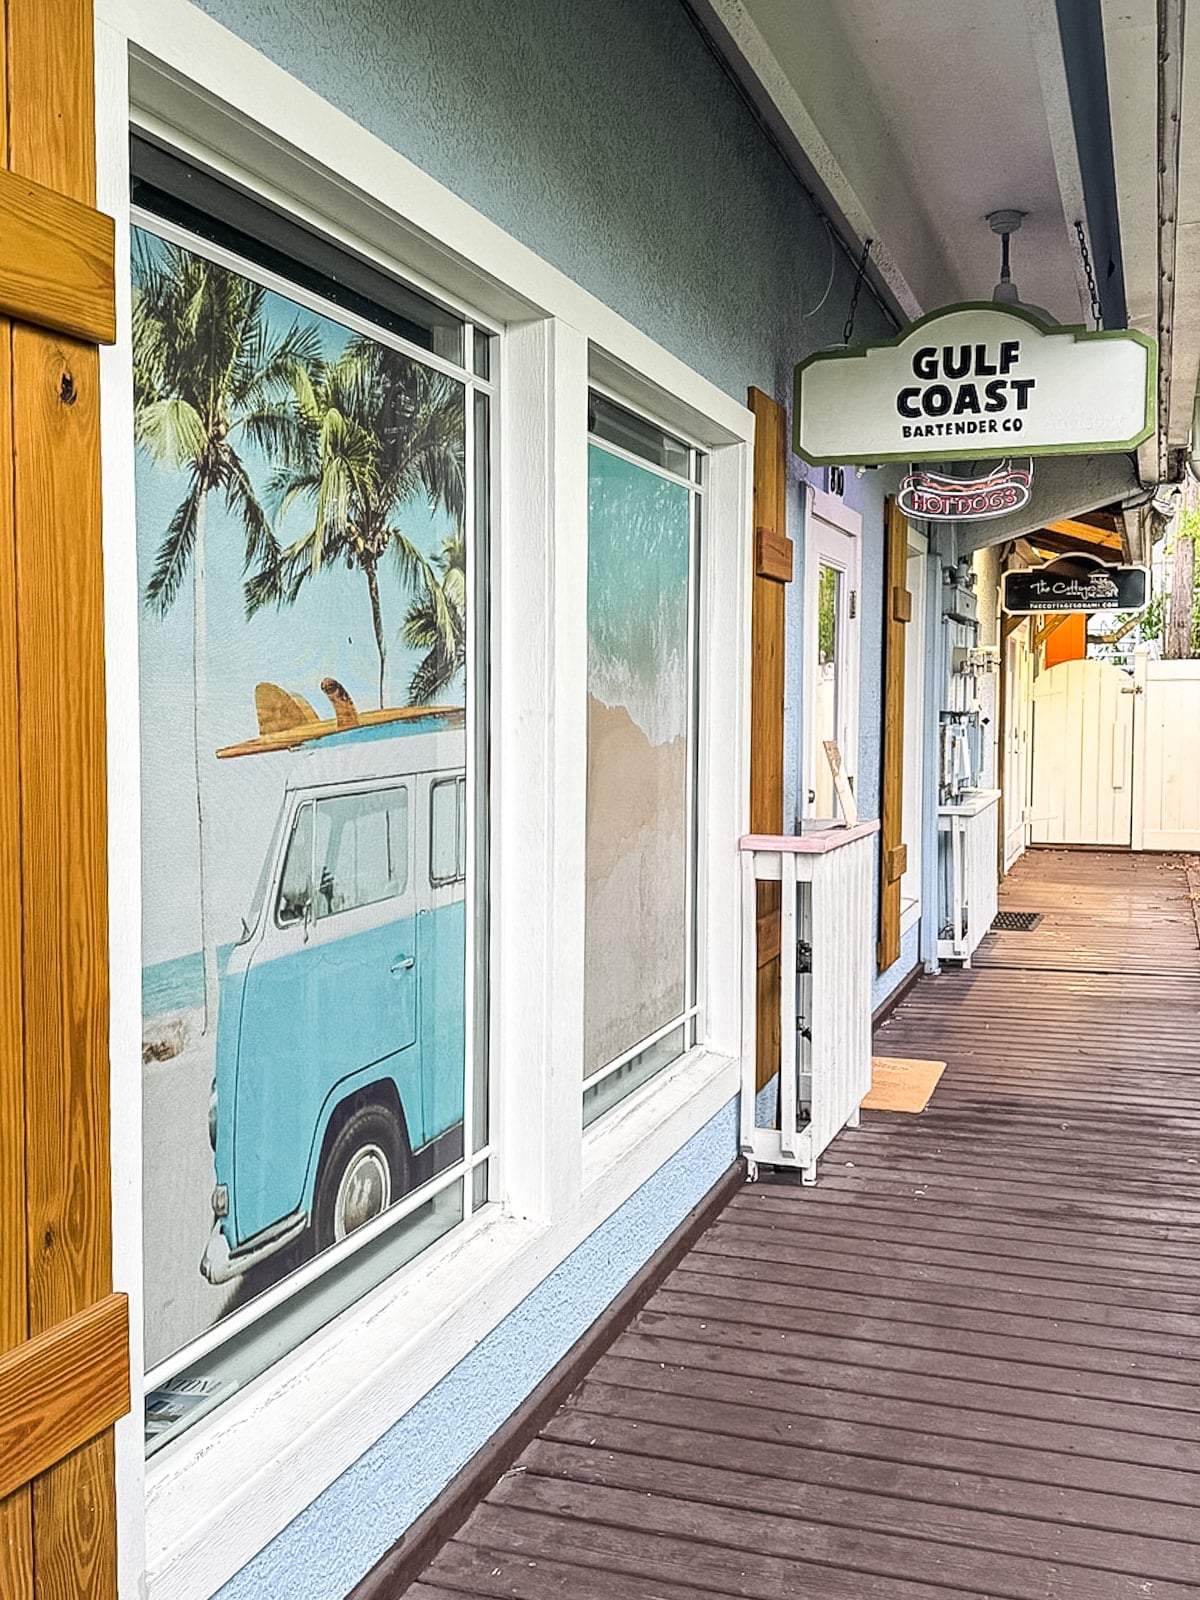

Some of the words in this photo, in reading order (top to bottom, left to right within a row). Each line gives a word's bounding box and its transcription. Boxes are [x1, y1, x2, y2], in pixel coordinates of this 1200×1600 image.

[912, 340, 1020, 381] GULF
[896, 379, 1036, 419] COAST
[902, 419, 998, 439] BARTENDER
[1002, 418, 1023, 433] CO
[911, 493, 950, 515] HOT
[956, 488, 1017, 515] DOGS
